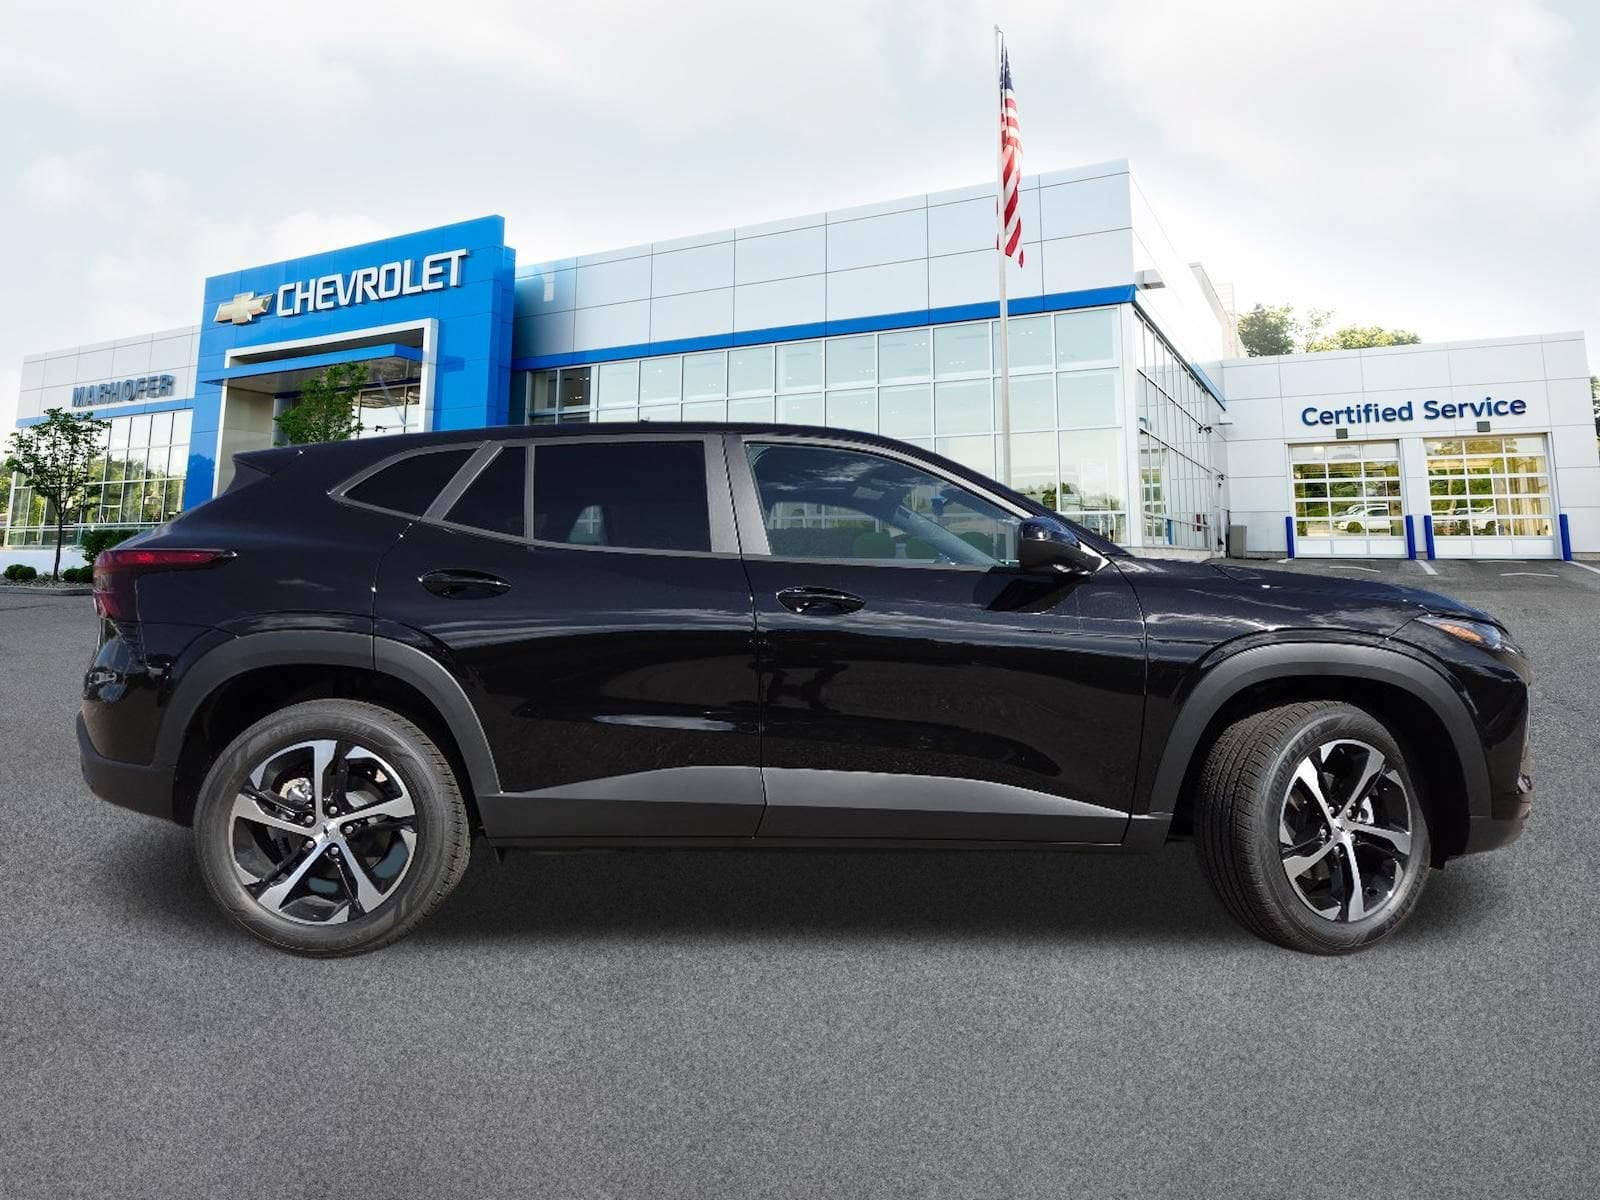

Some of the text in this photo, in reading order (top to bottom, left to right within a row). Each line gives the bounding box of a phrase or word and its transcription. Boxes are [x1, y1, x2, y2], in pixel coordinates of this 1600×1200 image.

[276, 248, 469, 317] CHEVROLET
[72, 374, 176, 407] MARHOFER
[1302, 397, 1527, 426] Certified Service
